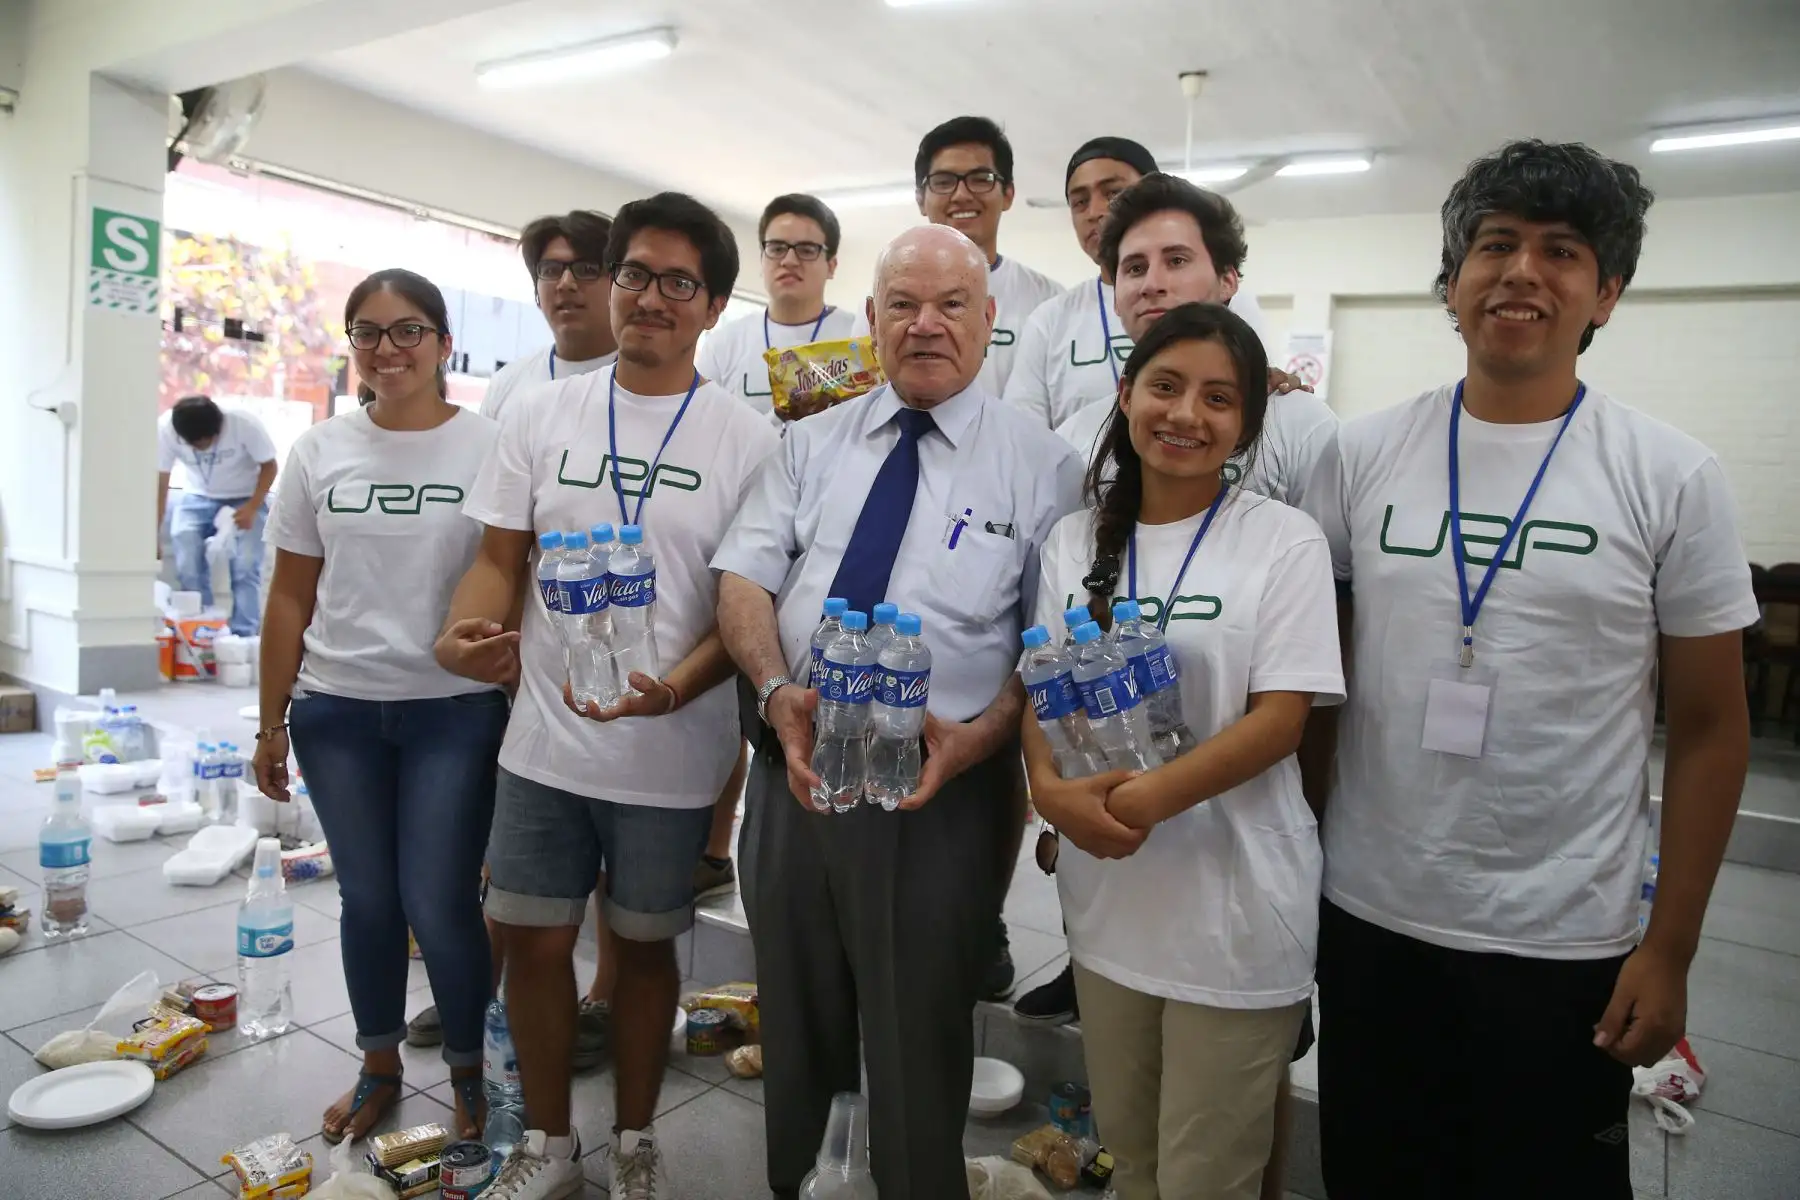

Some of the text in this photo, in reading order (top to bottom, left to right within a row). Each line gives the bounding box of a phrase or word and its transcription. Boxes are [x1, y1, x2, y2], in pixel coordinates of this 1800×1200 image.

[102, 217, 149, 272] S
[1071, 335, 1136, 366] UR
[558, 449, 702, 498] URP
[328, 484, 464, 515] URP
[1380, 504, 1598, 570] URP
